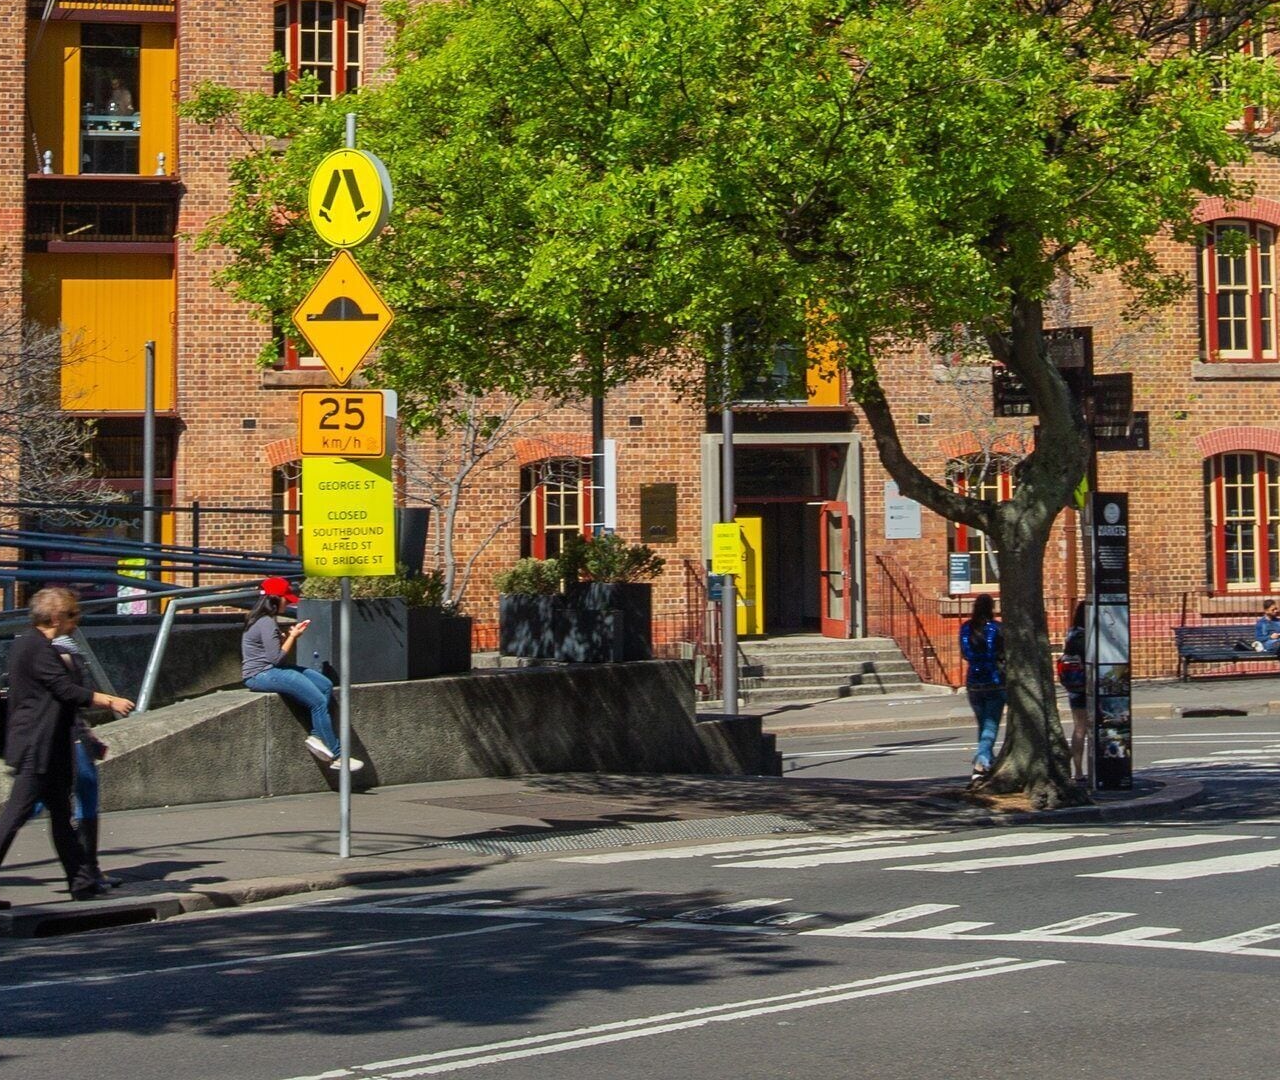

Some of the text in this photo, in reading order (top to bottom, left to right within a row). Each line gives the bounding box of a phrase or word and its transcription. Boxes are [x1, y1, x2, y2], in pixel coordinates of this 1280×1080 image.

[318, 397, 365, 431] 25
[322, 435, 361, 451] km/h
[318, 480, 376, 491] GEORGE ST
[327, 510, 368, 520] CLOSED
[313, 526, 384, 537] SOUTHBOUND
[322, 541, 372, 551] ALFRED ST
[314, 555, 383, 566] TO BRIDGE ST
